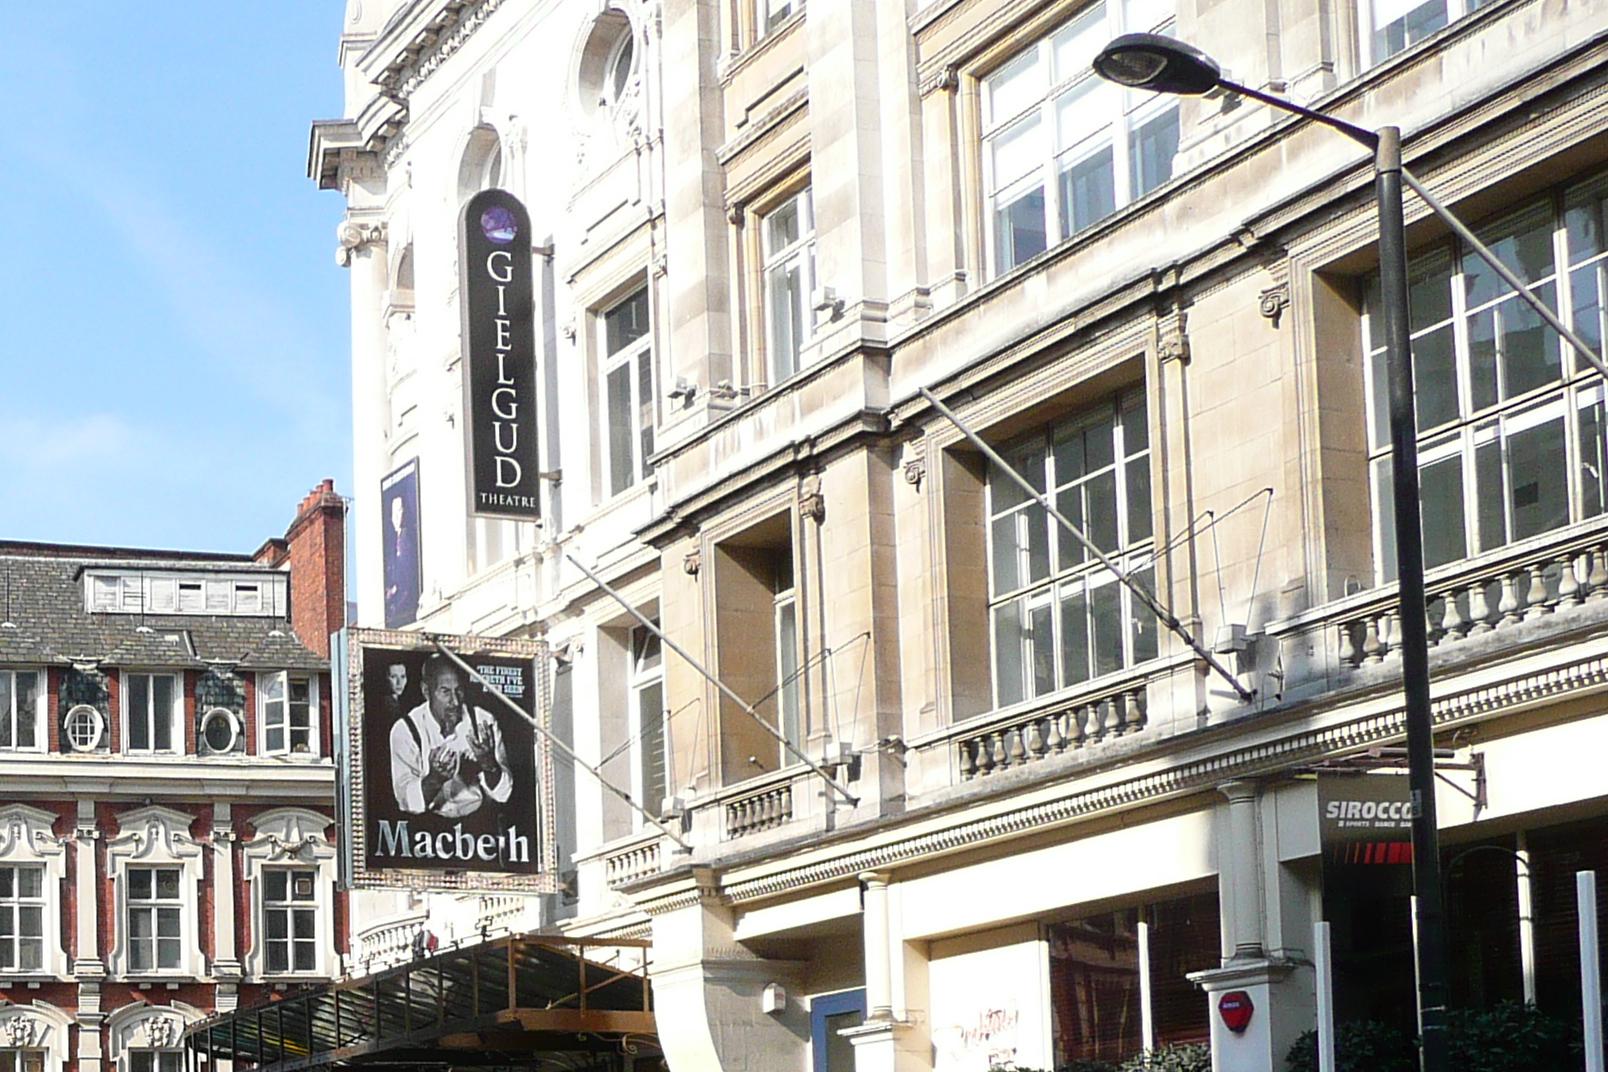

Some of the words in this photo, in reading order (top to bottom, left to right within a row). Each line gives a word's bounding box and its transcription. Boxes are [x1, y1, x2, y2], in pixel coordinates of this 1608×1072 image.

[487, 251, 522, 488] GIELGUD
[480, 492, 536, 508] THEATRE
[374, 819, 530, 867] Macbeth
